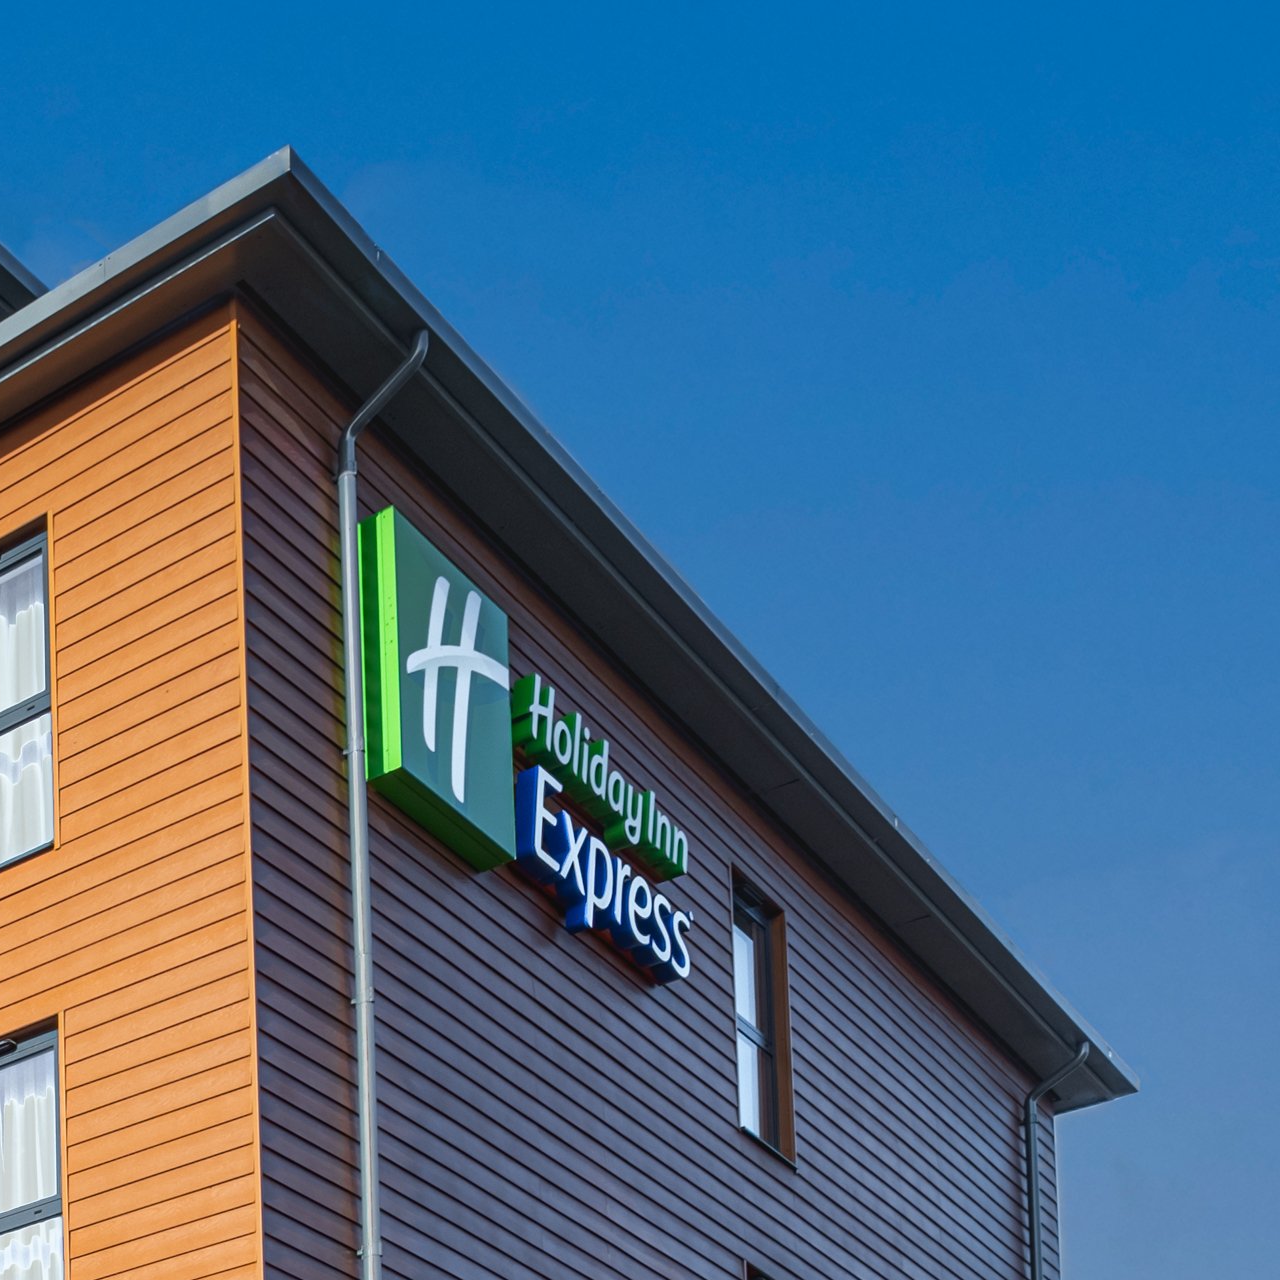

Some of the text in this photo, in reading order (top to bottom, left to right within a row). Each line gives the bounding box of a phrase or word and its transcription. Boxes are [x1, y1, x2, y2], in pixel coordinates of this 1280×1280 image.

[528, 673, 688, 874] Holiday Inn
[533, 764, 692, 979] Express
